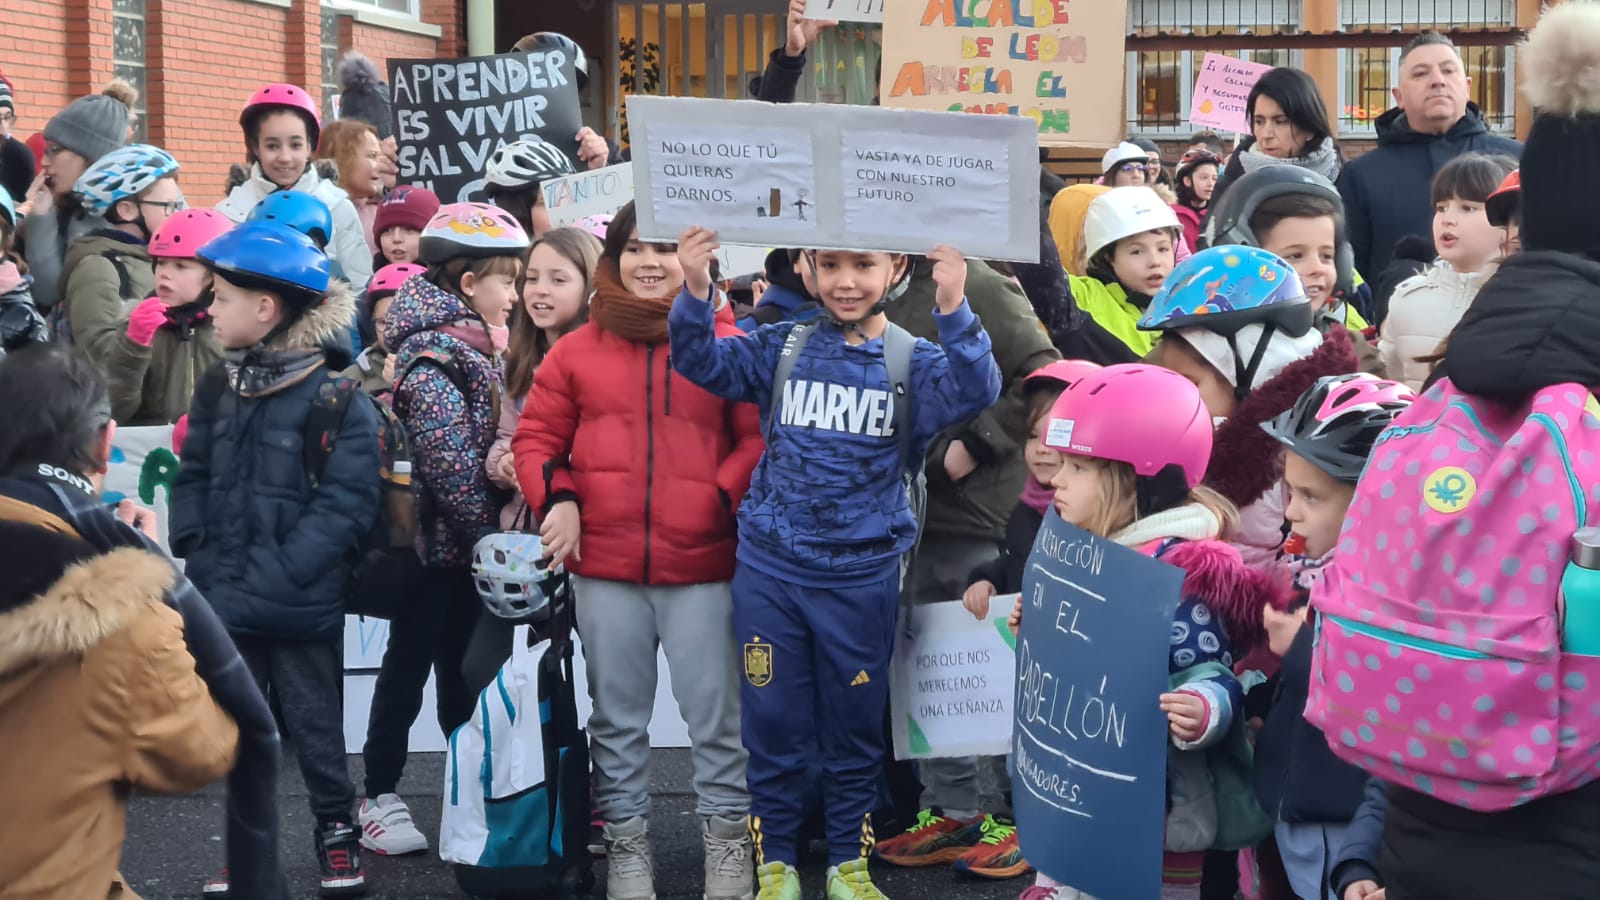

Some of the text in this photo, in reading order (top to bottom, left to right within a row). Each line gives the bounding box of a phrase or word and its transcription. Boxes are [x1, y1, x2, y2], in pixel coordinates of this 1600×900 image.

[920, 0, 1069, 27] ALCALDE
[961, 36, 993, 59] DE
[393, 50, 568, 104] APRENDER
[889, 61, 1012, 98] ARREGLA
[1036, 70, 1066, 97] EL
[398, 95, 548, 141] ES VIVIR
[662, 141, 777, 159] NO LO QUE TÚ
[856, 149, 994, 171] VASTA YA DE JUGAR
[663, 164, 734, 180] QUIERAS
[856, 168, 956, 188] CON NUESTRO
[544, 171, 618, 209] TANTO
[666, 186, 737, 202] DARNOS.
[781, 380, 895, 437] MARVEL
[37, 463, 95, 495] SONY
[1056, 600, 1090, 642] EL
[916, 648, 991, 670] POR QUE NOS
[918, 675, 987, 693] MERECEMOS
[1017, 639, 1127, 748] PABELLÓN
[920, 698, 1004, 718] UNA ESEÑANZA
